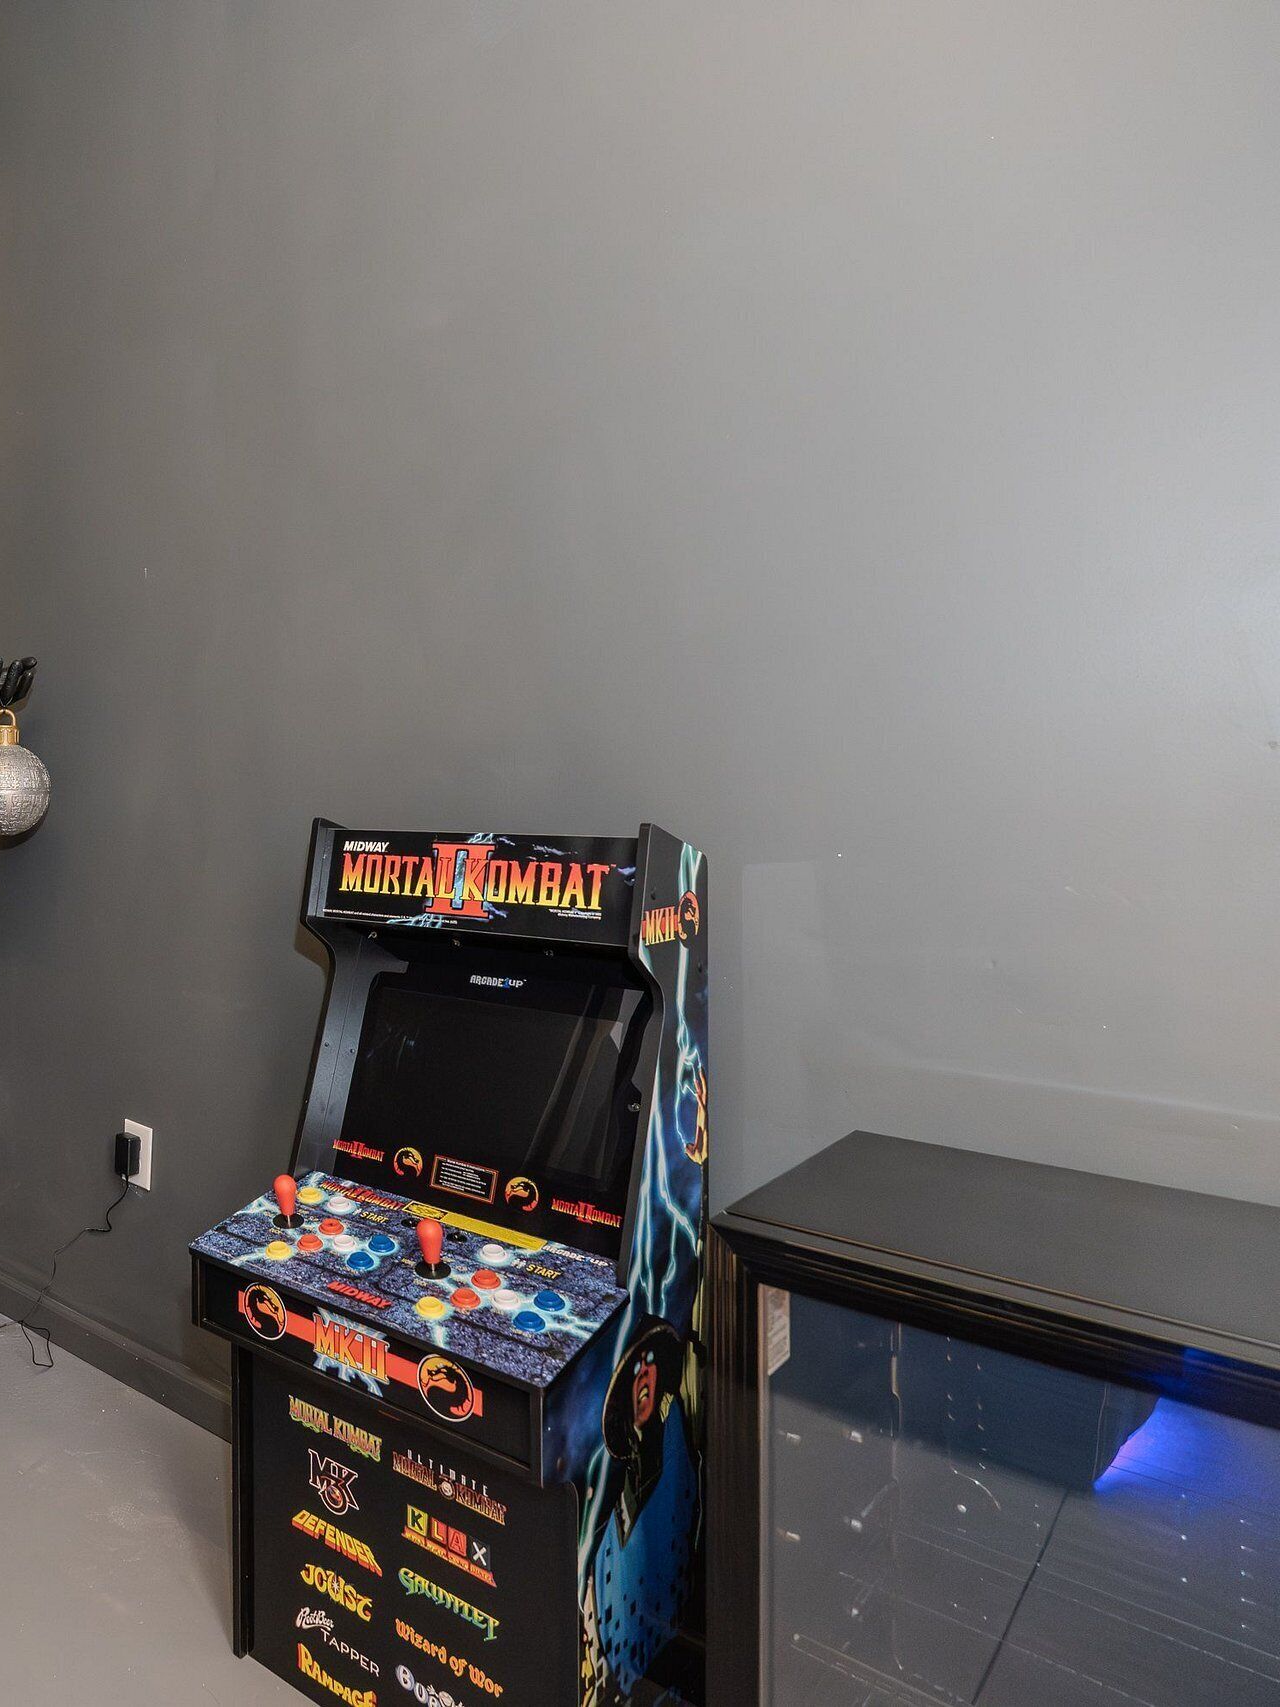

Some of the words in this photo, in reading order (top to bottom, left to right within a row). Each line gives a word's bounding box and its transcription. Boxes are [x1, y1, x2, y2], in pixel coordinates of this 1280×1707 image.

[343, 841, 389, 853] MIDWAY
[338, 853, 456, 899] MORTAL
[459, 857, 610, 910] KOMBAT
[360, 1211, 388, 1224] START
[327, 1280, 392, 1309] MIDWAY
[526, 1264, 561, 1280] START
[288, 1394, 333, 1436] MORTAL
[332, 1415, 383, 1460] KOMBAT
[407, 1449, 489, 1497] ULTIMATE
[291, 1509, 383, 1577] DEFENDER
[407, 1505, 488, 1567] KLAX
[300, 1563, 373, 1622] JOUST
[398, 1567, 501, 1642] GAUNTLET
[320, 1627, 381, 1678] TAPPER
[395, 1618, 447, 1665] Wizard
[449, 1656, 468, 1677] of
